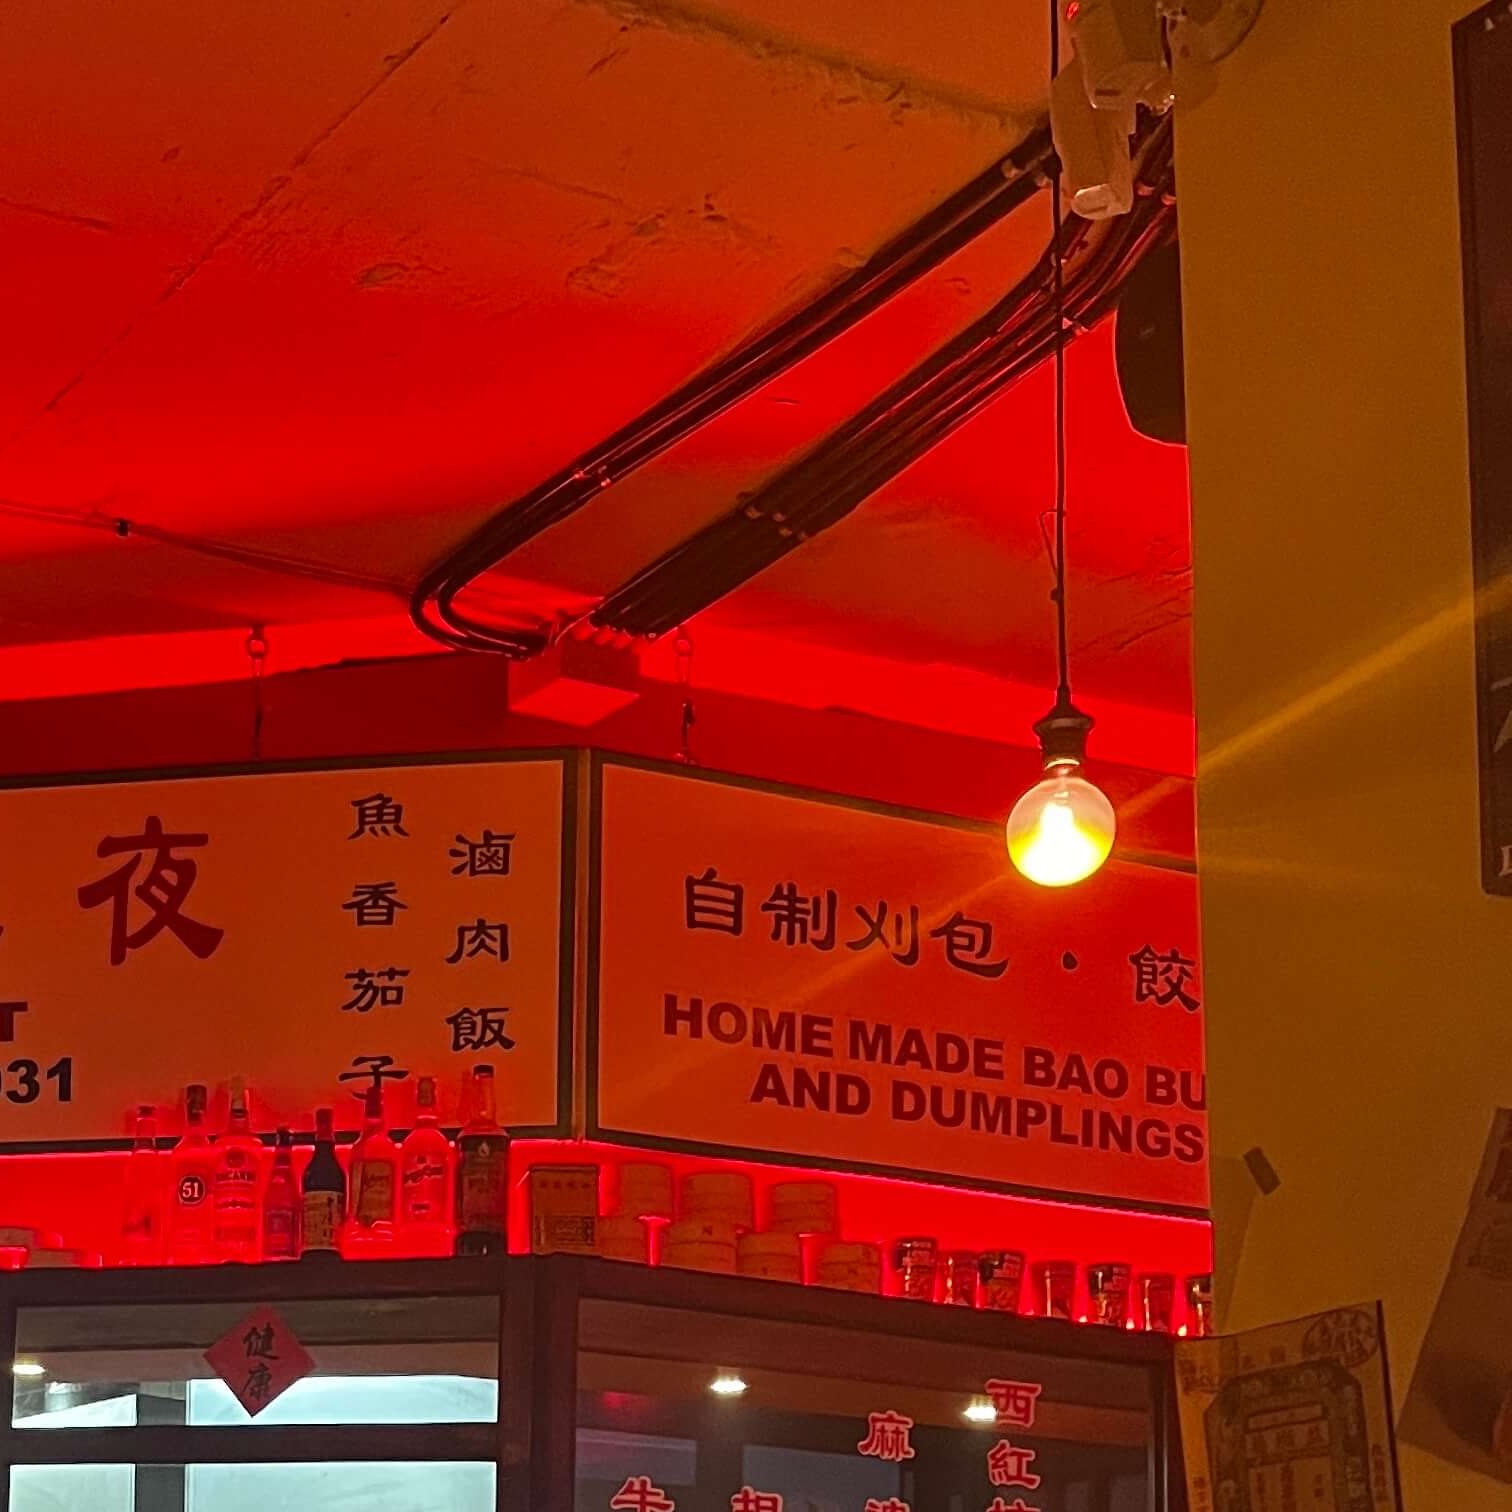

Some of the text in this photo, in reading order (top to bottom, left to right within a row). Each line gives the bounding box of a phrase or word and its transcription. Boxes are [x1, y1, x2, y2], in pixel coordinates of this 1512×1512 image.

[338, 792, 410, 1103] 魚香茄子
[445, 829, 517, 1052] 滷肉飯
[662, 993, 833, 1058] HOME
[847, 1019, 1006, 1081] MADE
[1022, 1046, 1129, 1100] BAO
[749, 1062, 1205, 1164] AND DUMPLINGS
[242, 1321, 280, 1401] 健康
